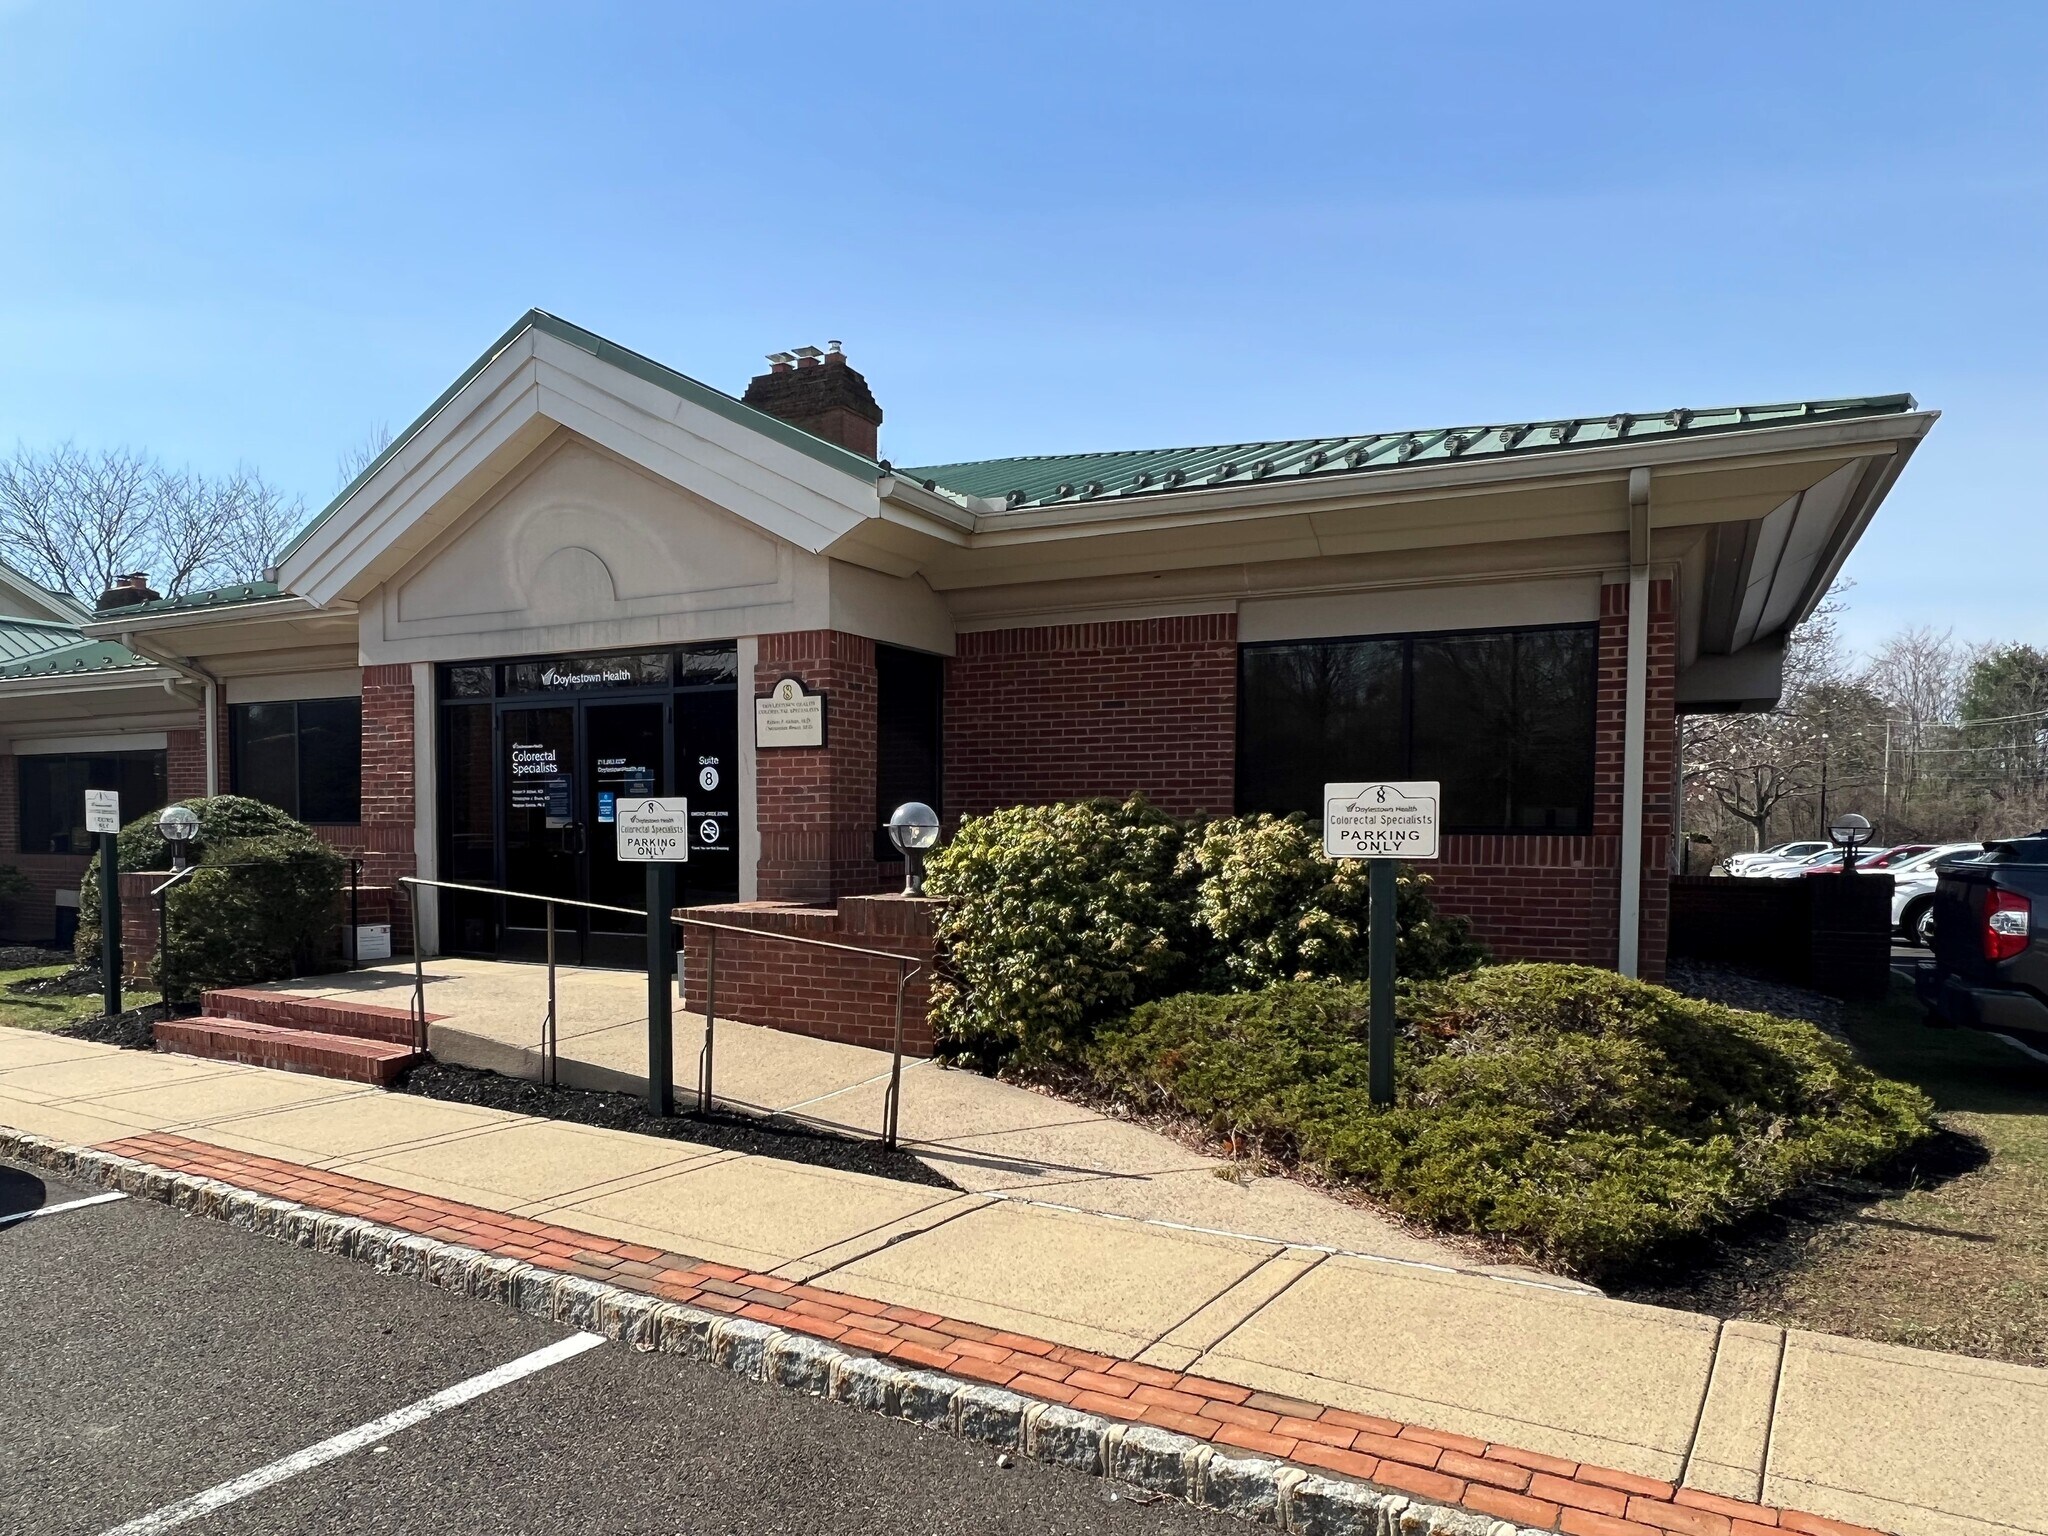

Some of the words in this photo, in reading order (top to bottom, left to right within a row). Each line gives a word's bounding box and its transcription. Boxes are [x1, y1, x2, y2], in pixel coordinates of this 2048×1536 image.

[553, 673, 601, 687] Doylestown
[602, 669, 631, 682] Health
[783, 684, 793, 700] 8
[512, 749, 556, 762] Colorectal
[698, 756, 719, 765] Suite
[512, 762, 558, 777] Specialists
[705, 771, 713, 786] 8
[1376, 788, 1386, 804] 8
[648, 802, 654, 814] 8
[1355, 806, 1394, 814] Doylestown
[1330, 815, 1377, 825] Colorectal
[1380, 814, 1433, 826] Specialists
[620, 825, 650, 834] Colorectal
[651, 825, 684, 835] Specialists
[1341, 830, 1420, 841] PARKING
[627, 838, 676, 847] PARKING
[1356, 841, 1403, 851] ONLY
[637, 847, 666, 856] ONLY
